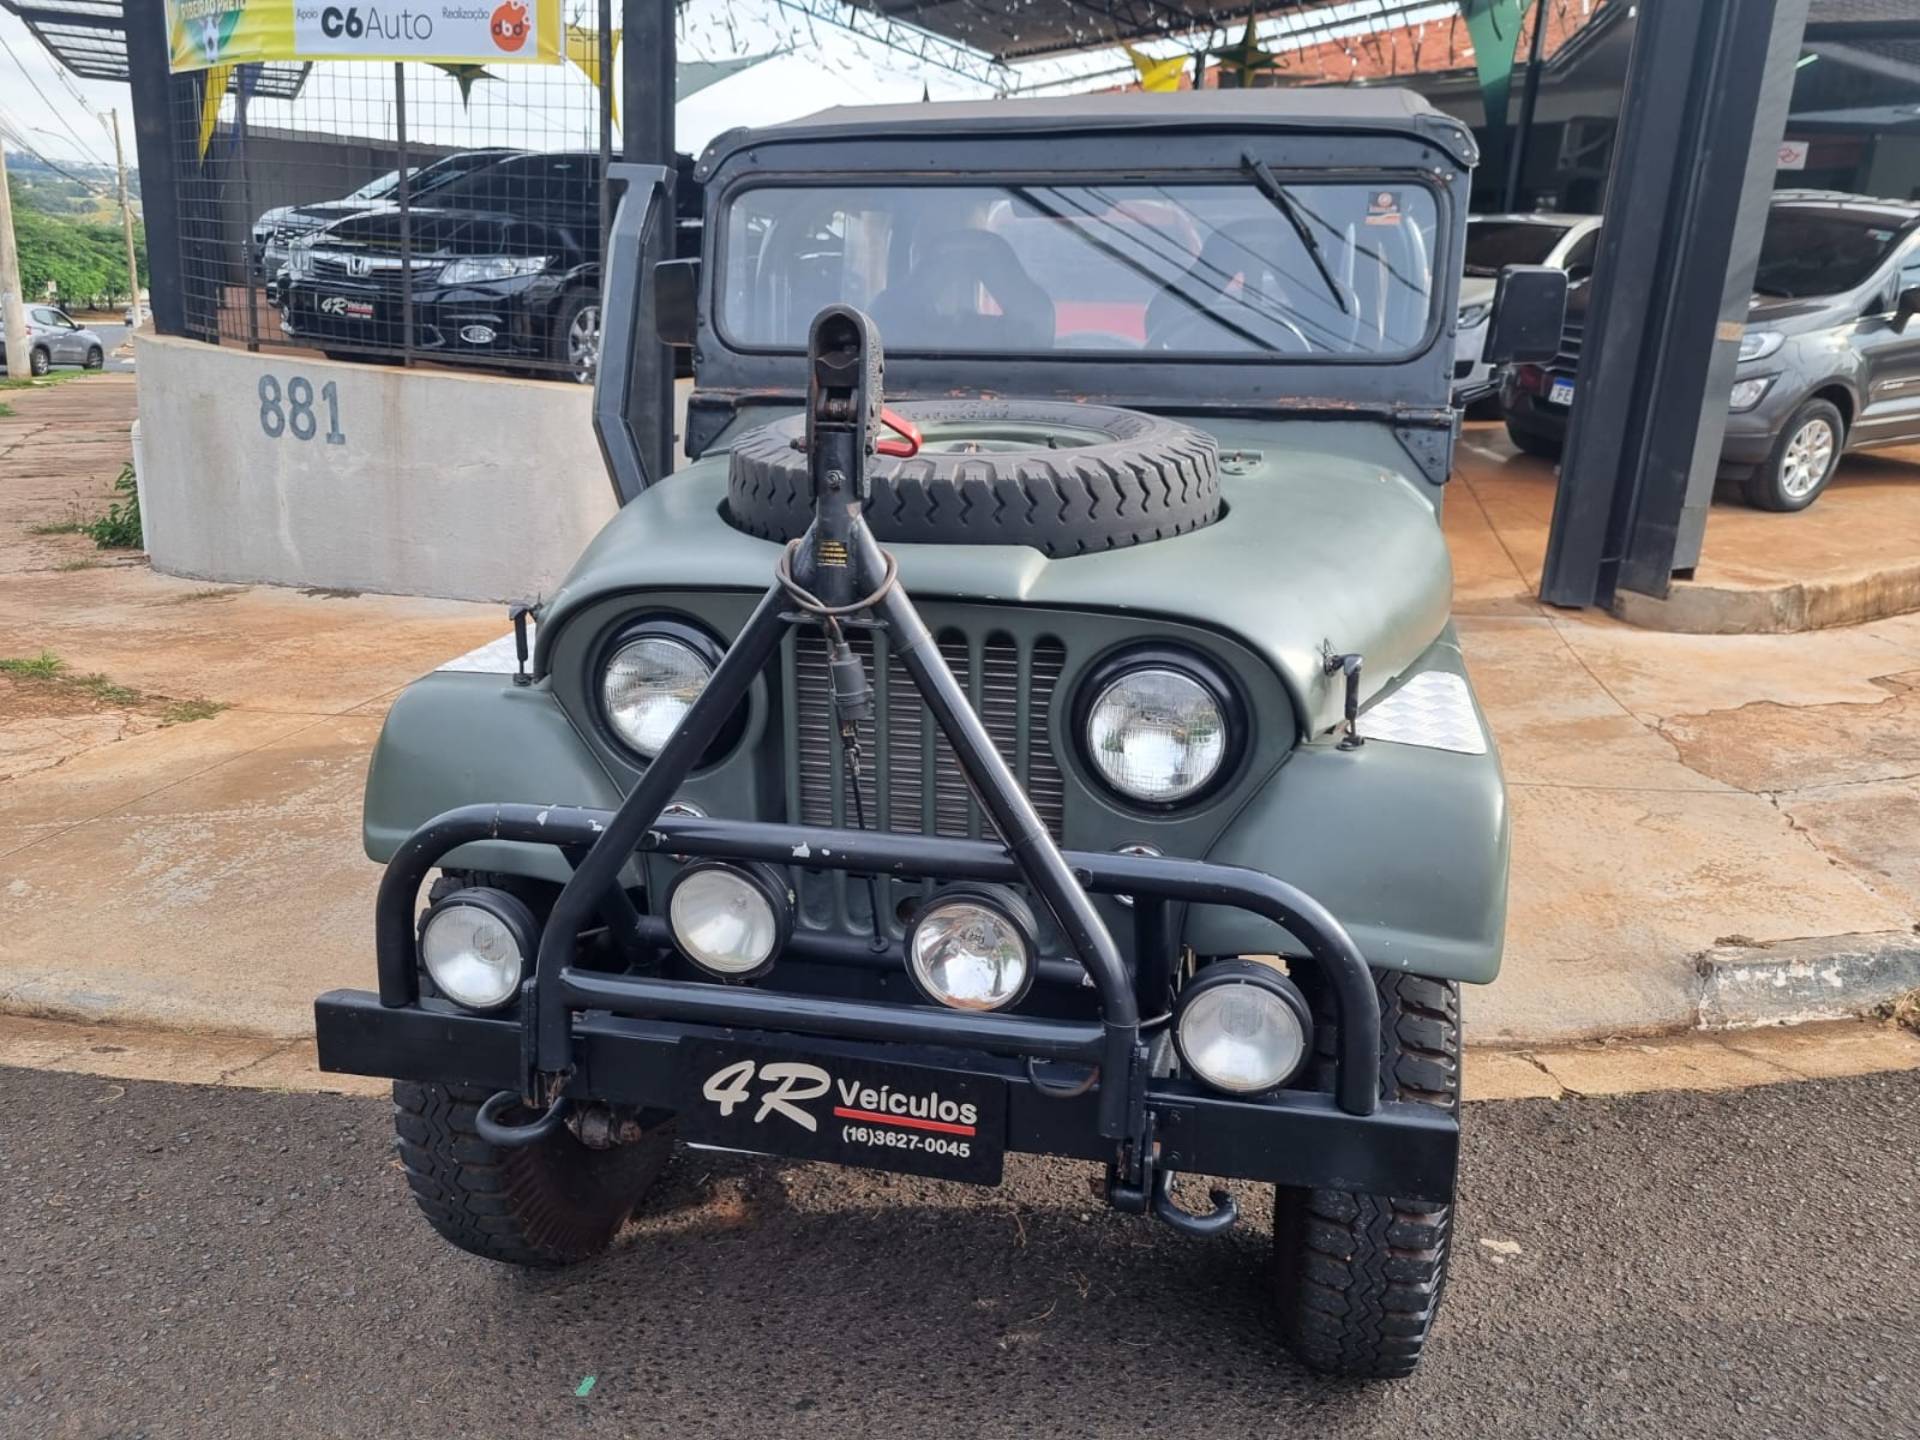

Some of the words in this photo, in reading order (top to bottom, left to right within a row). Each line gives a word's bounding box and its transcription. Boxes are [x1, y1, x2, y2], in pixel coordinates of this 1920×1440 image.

[297, 8, 318, 23] Apoio
[321, 6, 433, 40] C6Auto
[442, 6, 489, 21] Realização
[492, 18, 524, 37] dbd
[321, 297, 348, 315] 4R
[258, 374, 346, 445] 881
[702, 1060, 832, 1132] 4R
[837, 1078, 978, 1125] Veículos
[842, 1125, 971, 1159] (16)3627-0045
